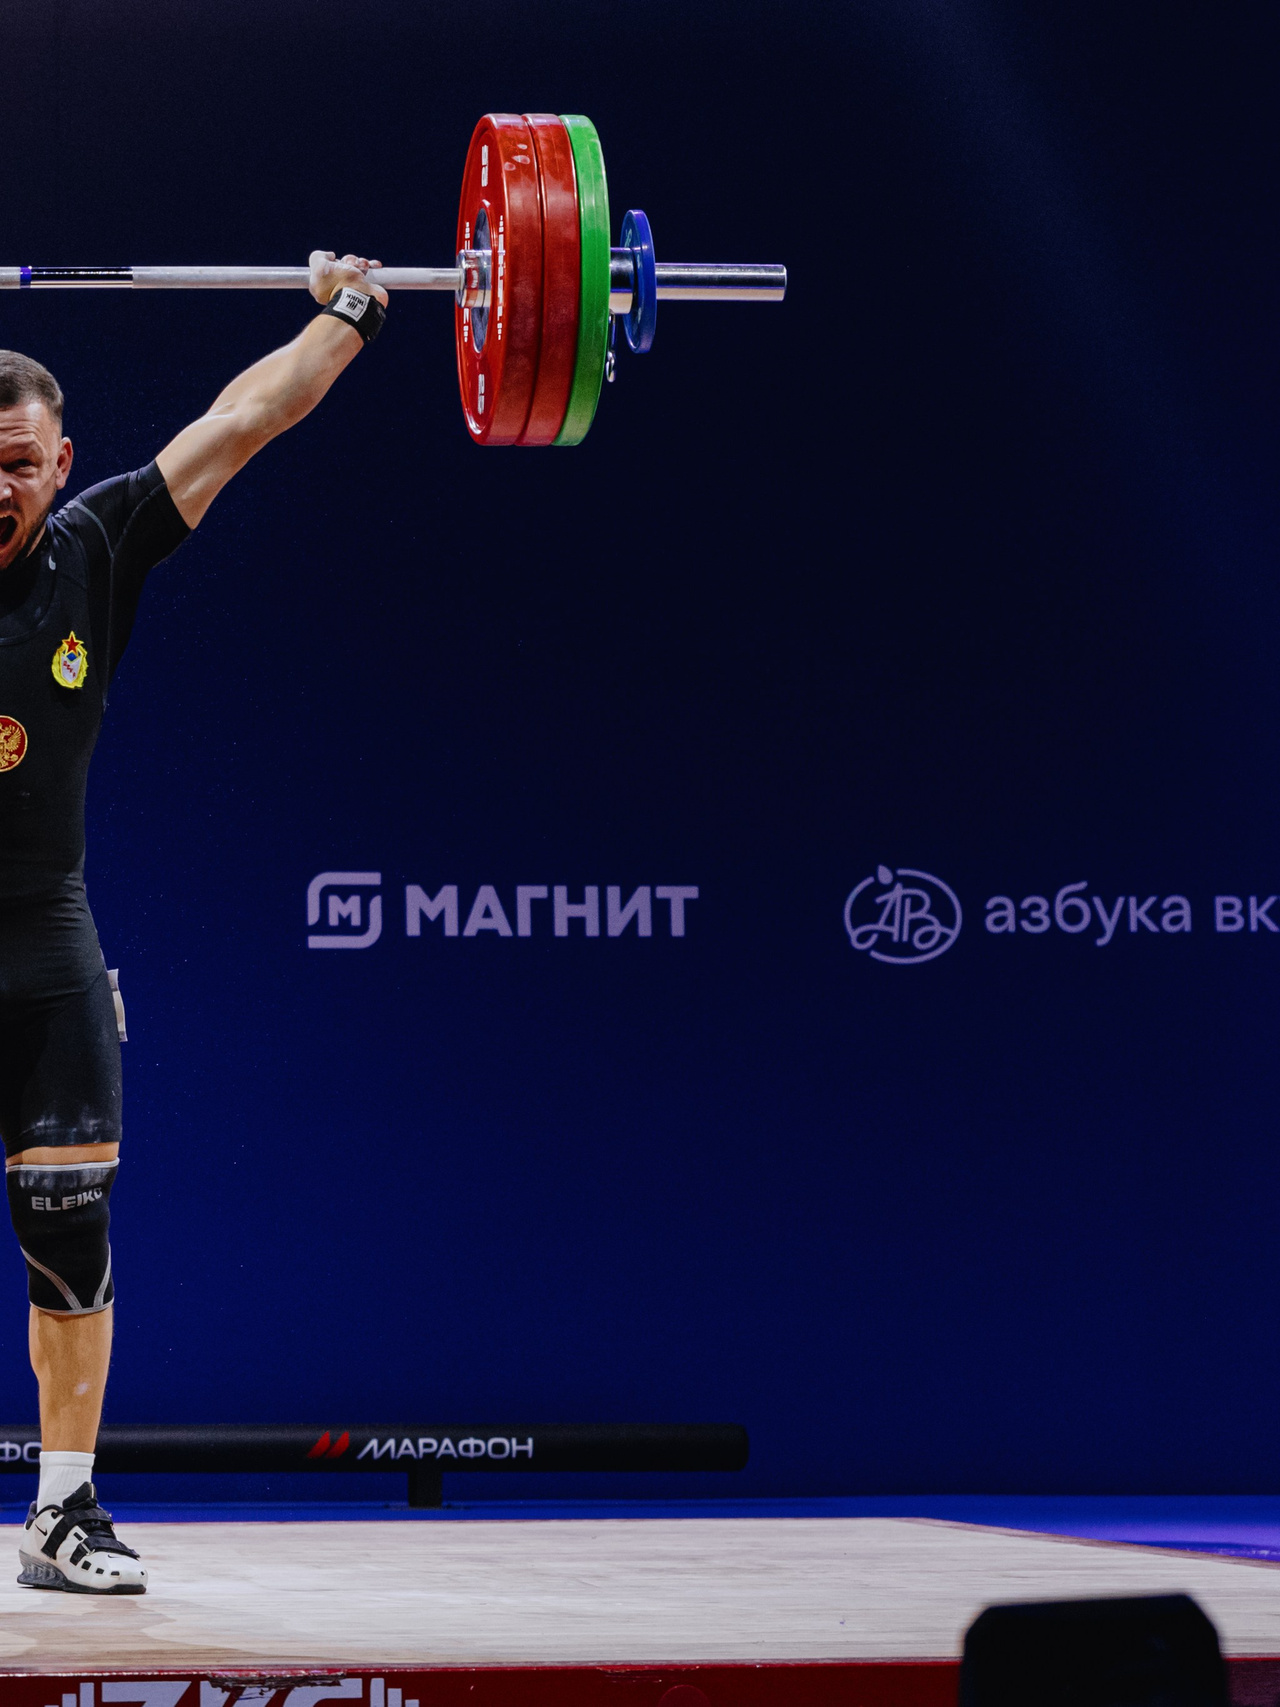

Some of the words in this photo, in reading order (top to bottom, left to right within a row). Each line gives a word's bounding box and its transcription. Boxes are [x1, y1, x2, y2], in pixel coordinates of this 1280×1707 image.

[405, 884, 700, 937] МАГНИТ
[984, 880, 1192, 947] азбука
[1214, 895, 1280, 932] вк
[31, 1186, 103, 1211] ELEIKO
[356, 1436, 534, 1459] МАРАФОН
